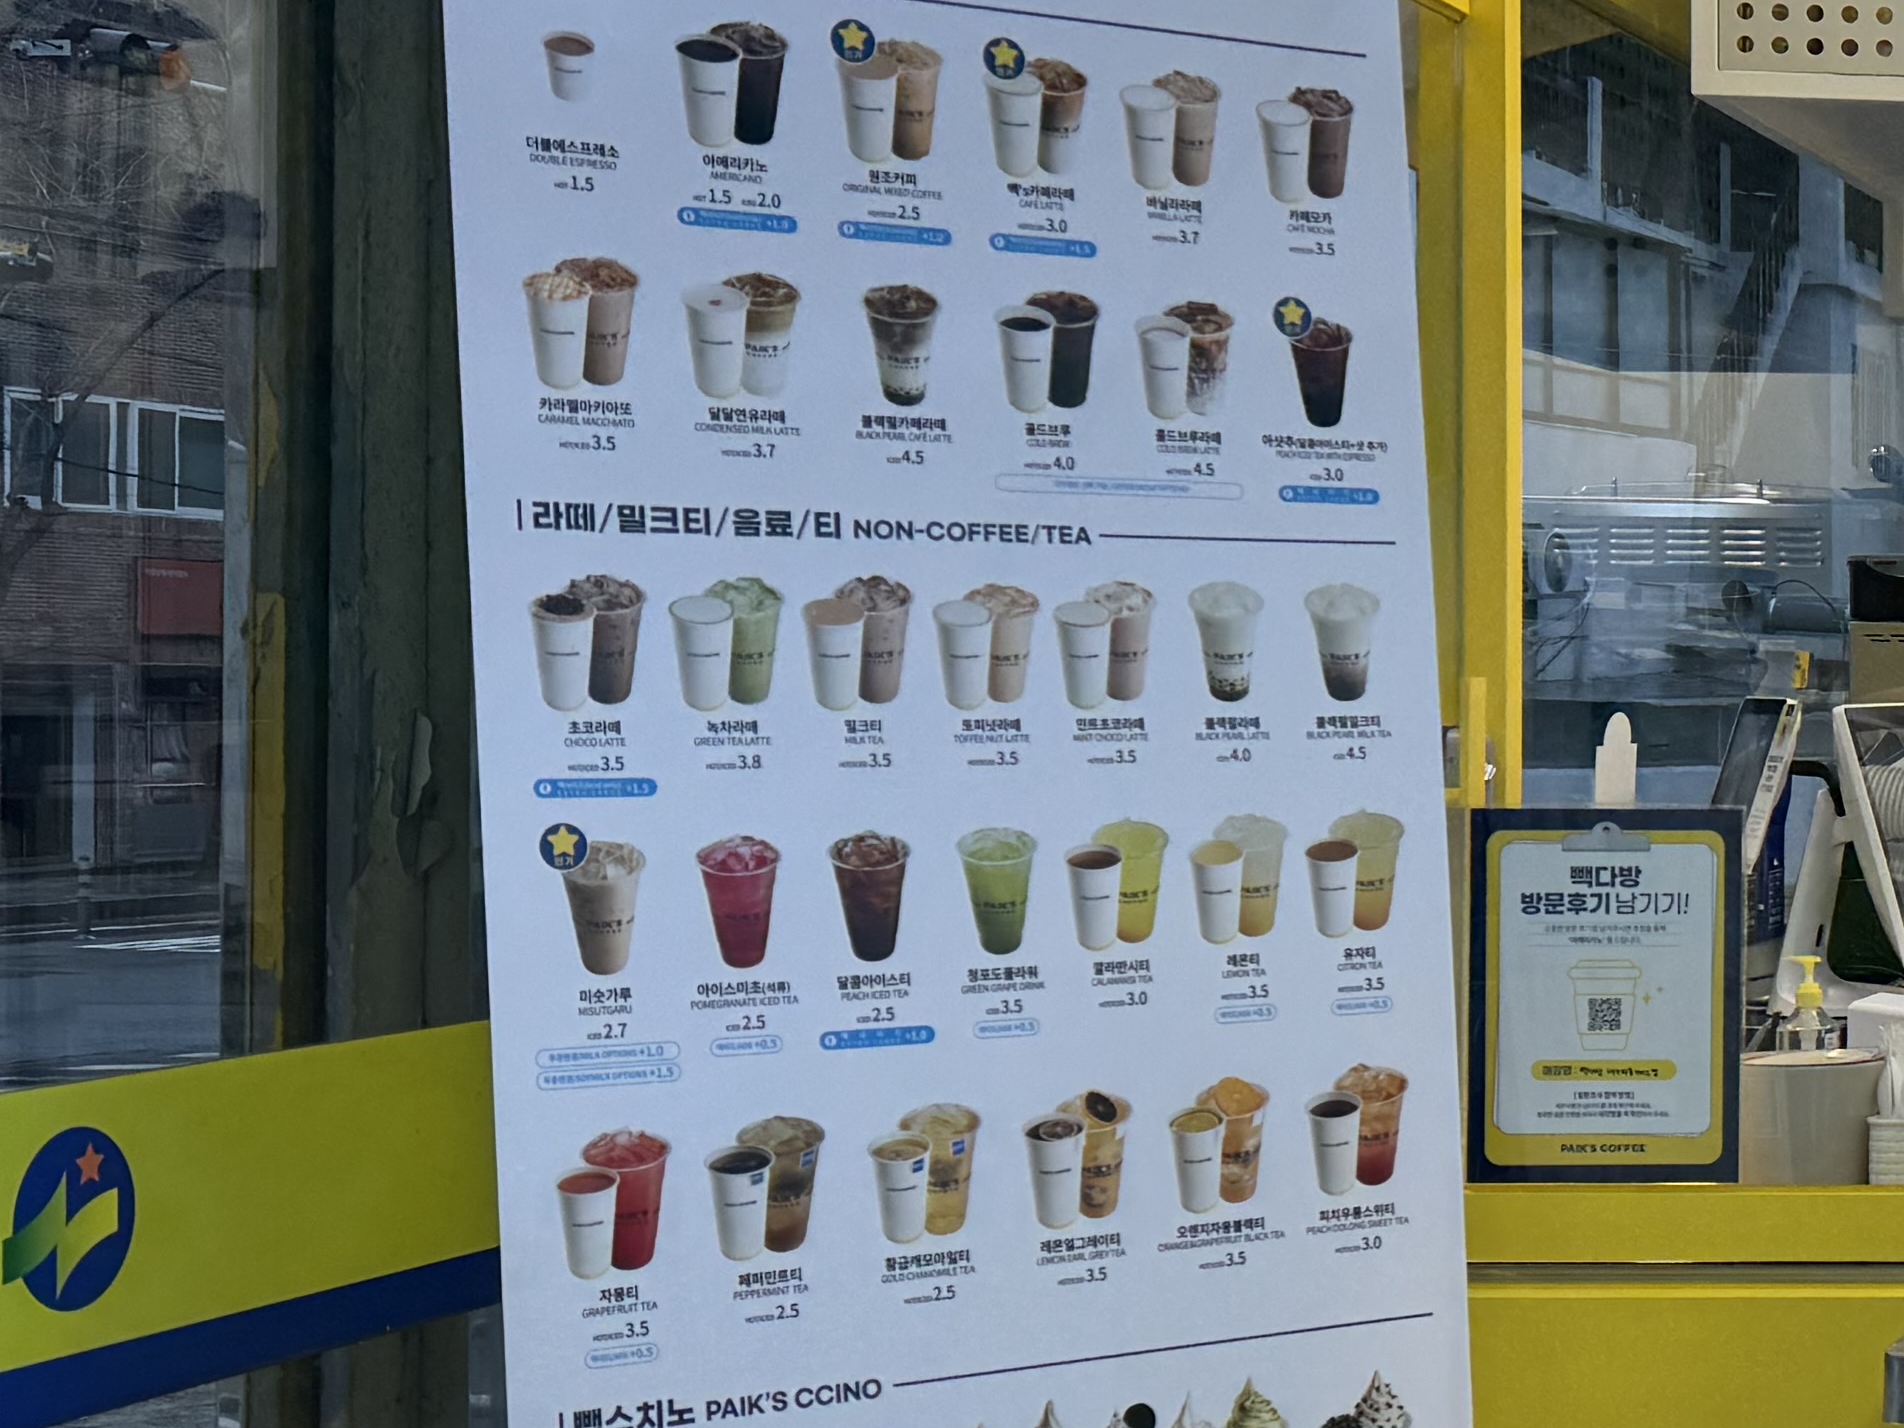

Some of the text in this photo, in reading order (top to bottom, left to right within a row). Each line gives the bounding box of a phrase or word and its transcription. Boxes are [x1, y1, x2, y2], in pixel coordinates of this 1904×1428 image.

[526, 135, 620, 158] 더블에스프레소
[703, 153, 768, 172] 아메리카노
[571, 176, 595, 192] 1.5
[709, 189, 781, 208] 1.5 2.0
[898, 205, 920, 221] 2.5
[1045, 219, 1067, 233] 3.0
[1179, 230, 1200, 244] 3.7
[1316, 242, 1335, 256] 3.5
[539, 397, 632, 416] 카라멜마키아또
[708, 407, 786, 424] 달달연유라떼
[592, 436, 616, 451] 3.5
[752, 444, 775, 458] 3.7
[901, 450, 924, 464] 4.5
[1053, 456, 1074, 471] 4.0
[1193, 462, 1215, 476] 4.5
[1323, 468, 1343, 482] 3.0
[532, 500, 1092, 545] 라떼/밀크티/음료/티 NON-COFFEE/TEA
[568, 721, 621, 736] 초코라떼
[707, 719, 758, 735] 녹차라떼
[845, 719, 882, 734] 밀크티
[868, 753, 891, 768] 3.5
[997, 750, 1019, 765] 3.5
[1115, 750, 1137, 764] 3.5
[1230, 748, 1251, 763] 4.0
[1346, 746, 1367, 760] 4.5
[601, 756, 625, 772] 3.5
[738, 755, 761, 769] 3.8
[1569, 866, 1641, 888] 빽다방
[1521, 892, 1689, 916] 방문후기 남기기!
[1227, 953, 1260, 967] 레몬티
[1343, 947, 1376, 960] 유자티
[837, 972, 911, 991] 달콤아이스티
[1364, 978, 1384, 991] 3.5
[579, 987, 632, 1005] 미숫가루
[1126, 992, 1148, 1006] 3.0
[1248, 984, 1269, 999] 3.5
[1000, 999, 1023, 1014] 3.5
[871, 1007, 895, 1022] 2.5
[743, 1015, 765, 1030] 2.5
[603, 1023, 627, 1040] 2.7
[1600, 1144, 1646, 1153] COFFEE
[1361, 1237, 1382, 1250] 3.0
[1225, 1252, 1246, 1267] 3.5
[1086, 1268, 1107, 1283] 3.5
[599, 1285, 639, 1304] 자몽티
[932, 1286, 956, 1301] 2.5
[776, 1304, 800, 1320] 2.5
[625, 1322, 649, 1339] 3.5
[706, 1391, 788, 1422] PAIK'S
[794, 1378, 881, 1408] CCINO
